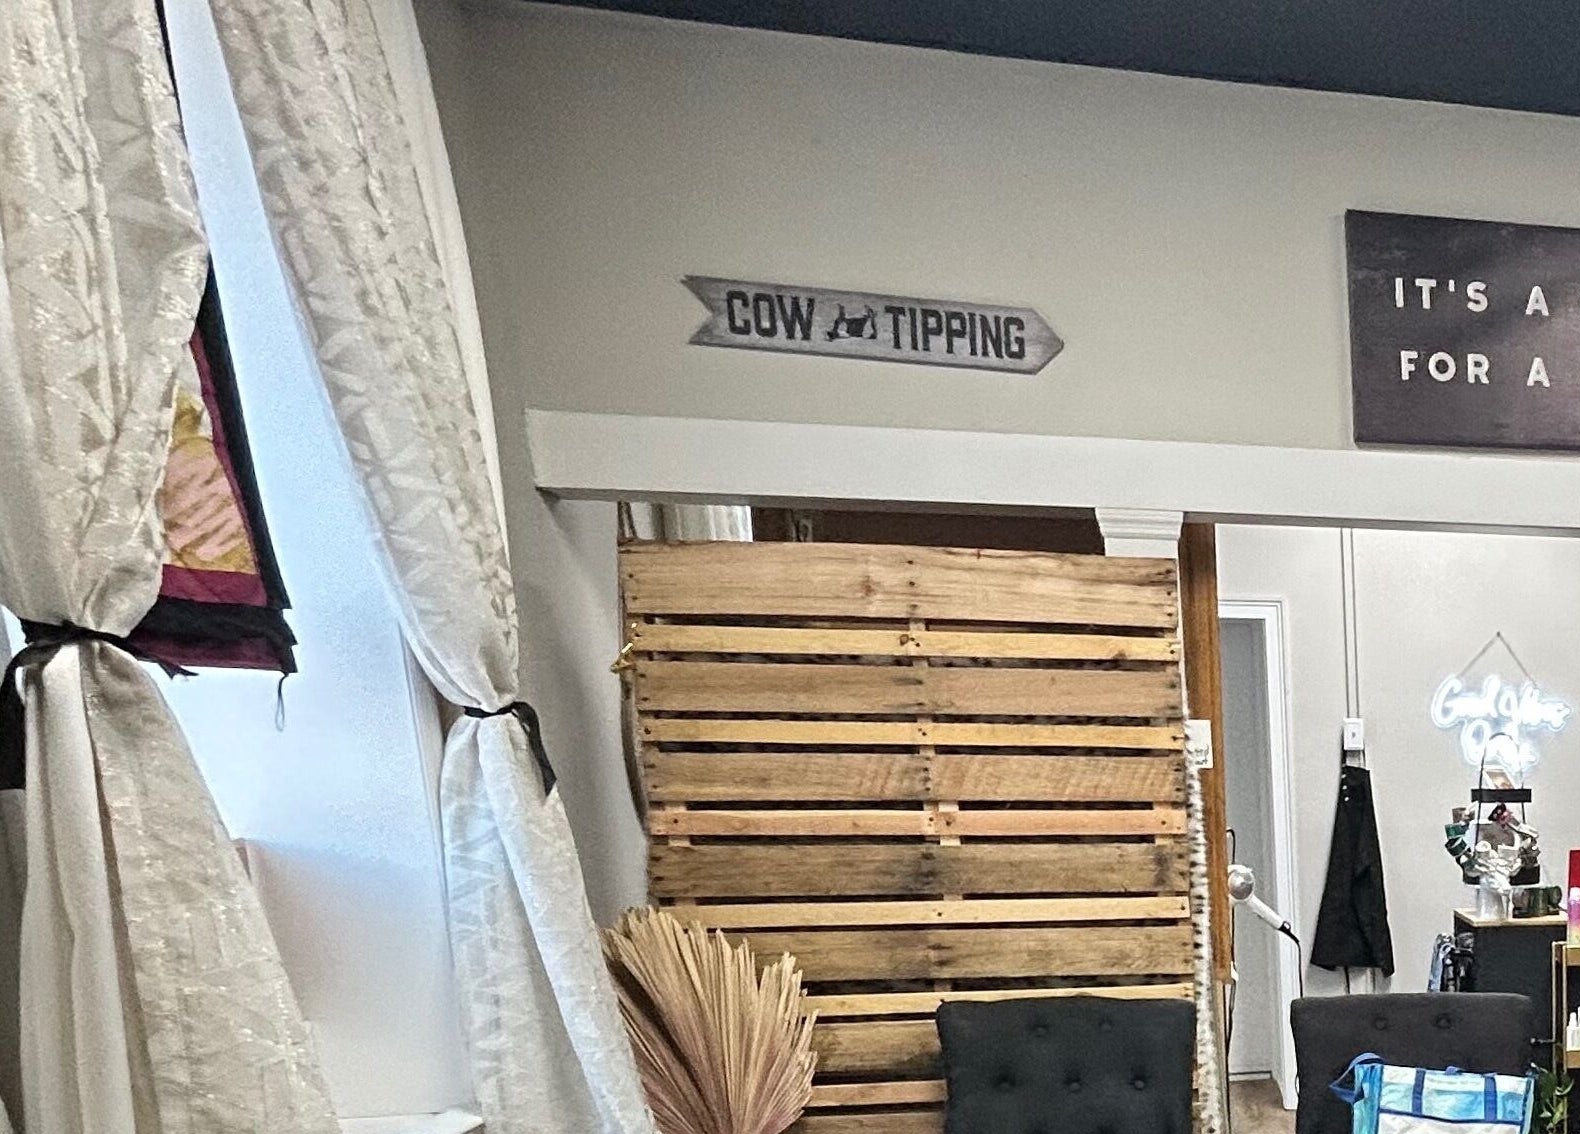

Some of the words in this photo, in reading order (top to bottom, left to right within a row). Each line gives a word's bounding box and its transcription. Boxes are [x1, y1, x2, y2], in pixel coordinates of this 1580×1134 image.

[1395, 277, 1489, 312] IT'S
[1525, 286, 1549, 316] A
[726, 290, 814, 341] COW
[884, 306, 1026, 360] TIPPING
[1400, 350, 1490, 384] FOR
[1527, 357, 1550, 387] A
